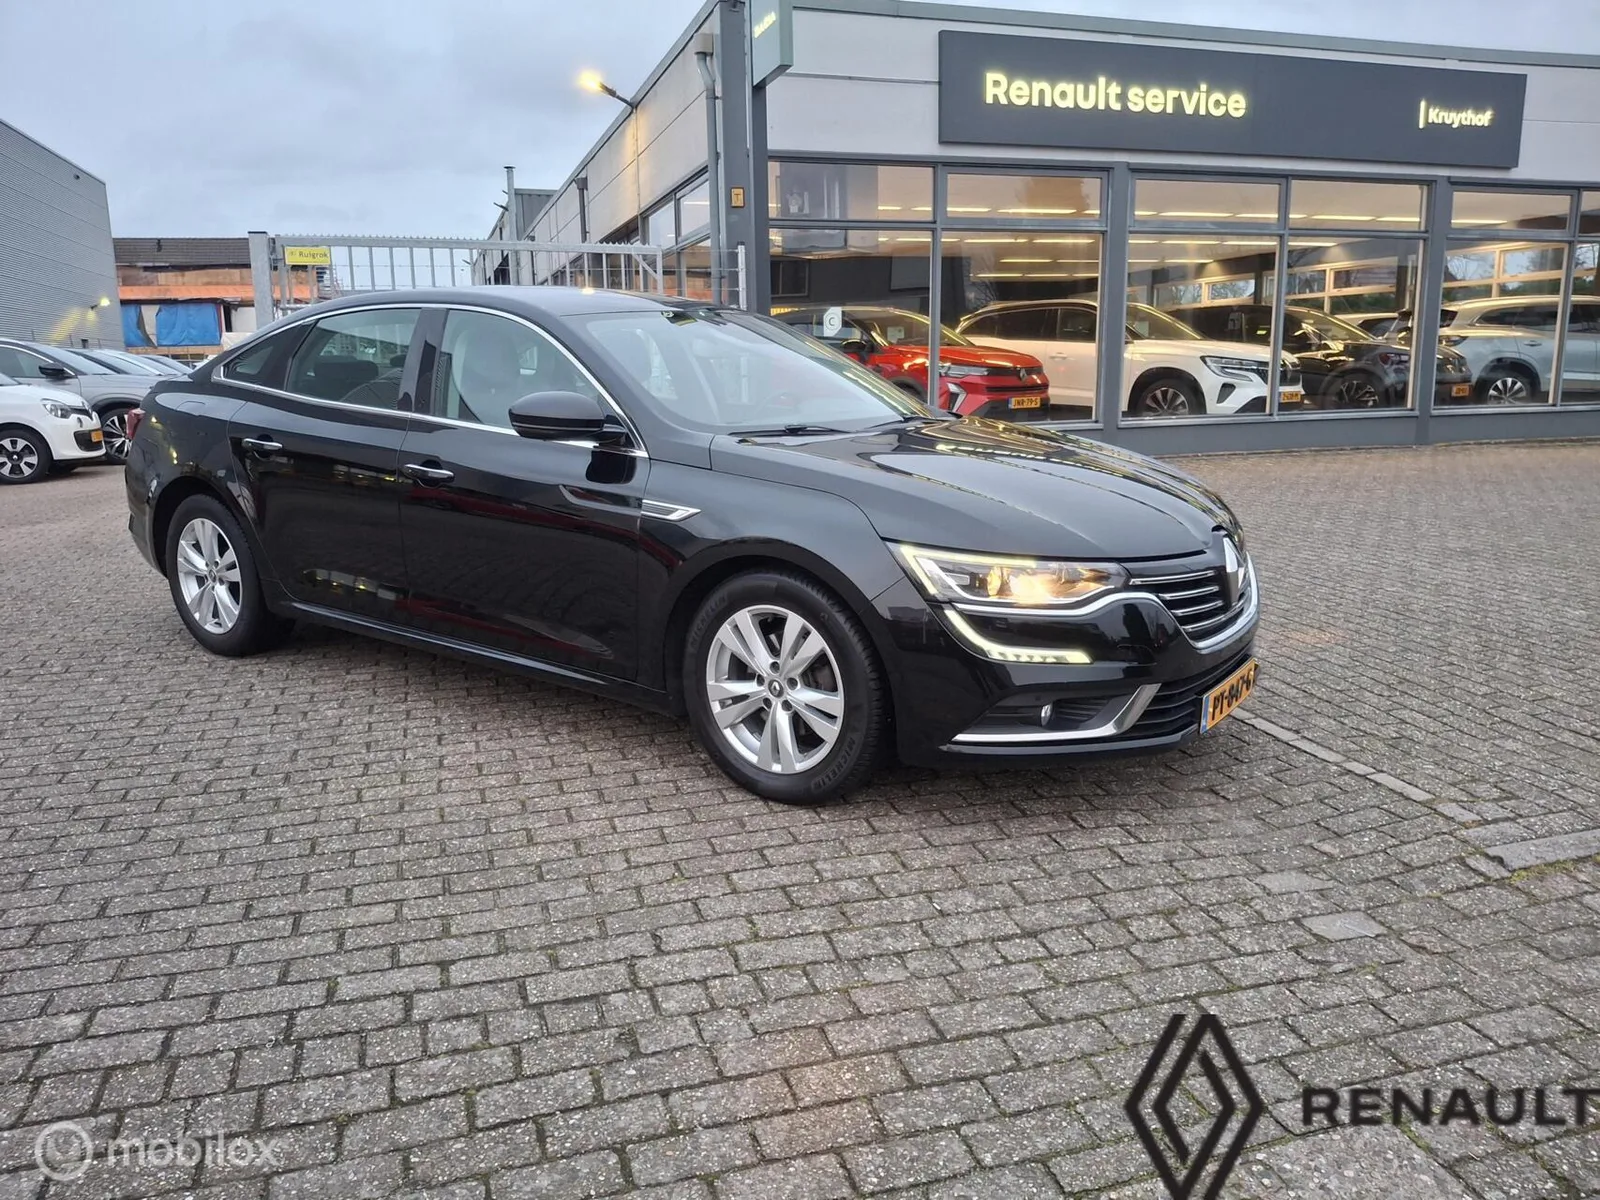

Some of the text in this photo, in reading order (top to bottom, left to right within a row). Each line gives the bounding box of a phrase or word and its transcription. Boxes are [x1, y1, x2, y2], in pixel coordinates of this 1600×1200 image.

[985, 72, 1247, 118] Renault service
[1428, 108, 1492, 128] Kruythof
